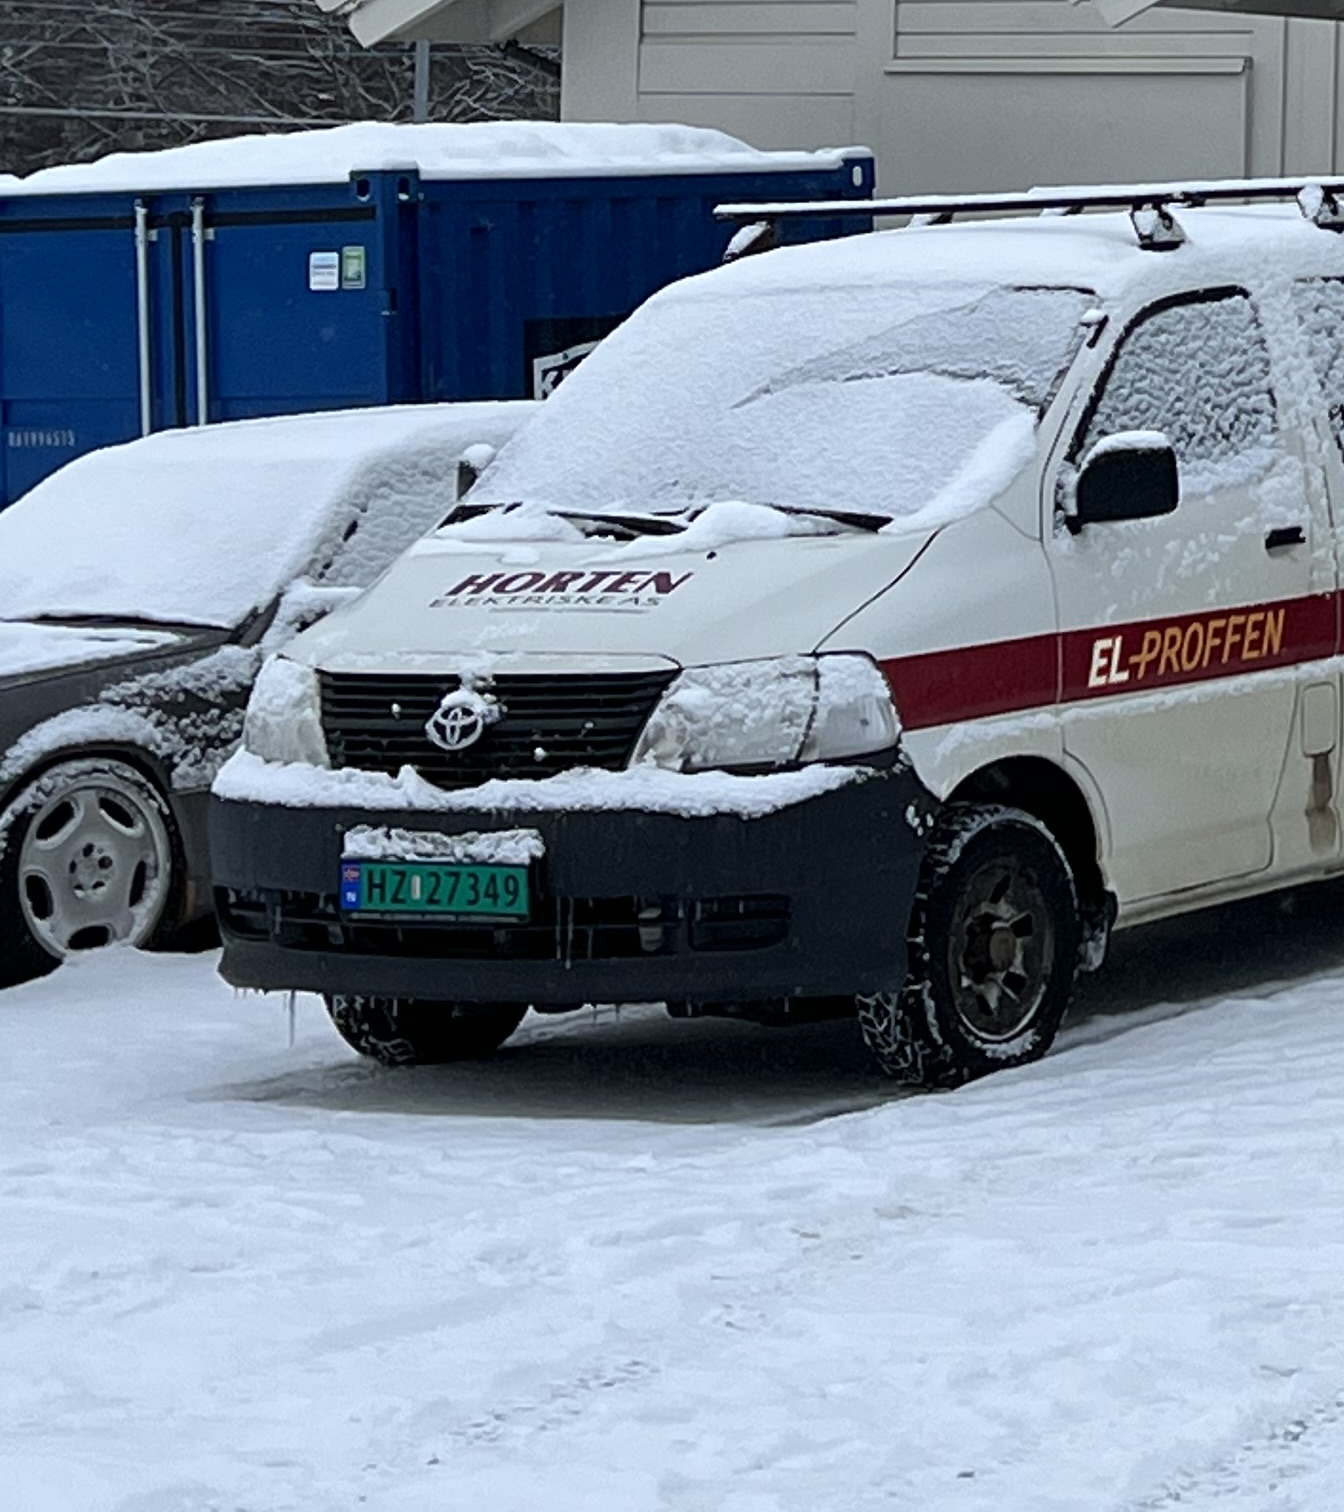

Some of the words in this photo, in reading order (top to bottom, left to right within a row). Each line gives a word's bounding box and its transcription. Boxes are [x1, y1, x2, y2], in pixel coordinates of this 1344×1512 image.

[444, 571, 695, 597] HORTEN
[429, 595, 615, 608] ELEKTRISKE
[617, 596, 664, 607] AS
[1088, 609, 1286, 688] EL-PROFFEN
[367, 869, 407, 905] HZ
[425, 871, 520, 907] 27349
